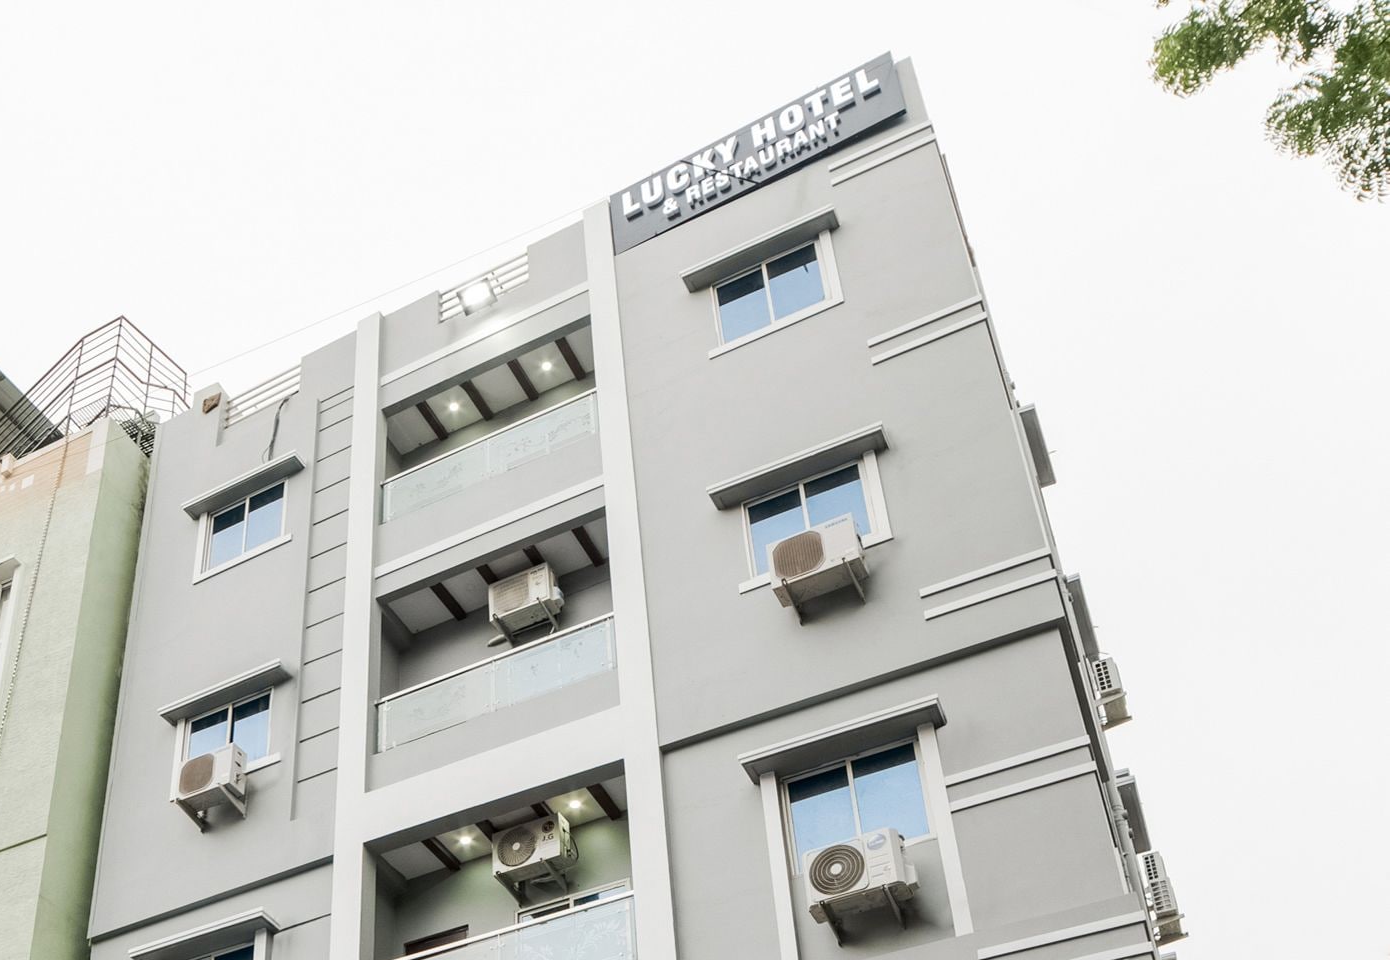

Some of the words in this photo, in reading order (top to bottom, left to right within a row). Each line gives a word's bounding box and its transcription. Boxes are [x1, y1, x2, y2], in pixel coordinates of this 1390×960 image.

[622, 135, 739, 217] LUCKY
[751, 68, 880, 148] HOTEL
[662, 198, 681, 219] &
[686, 111, 840, 209] RESTAURANT
